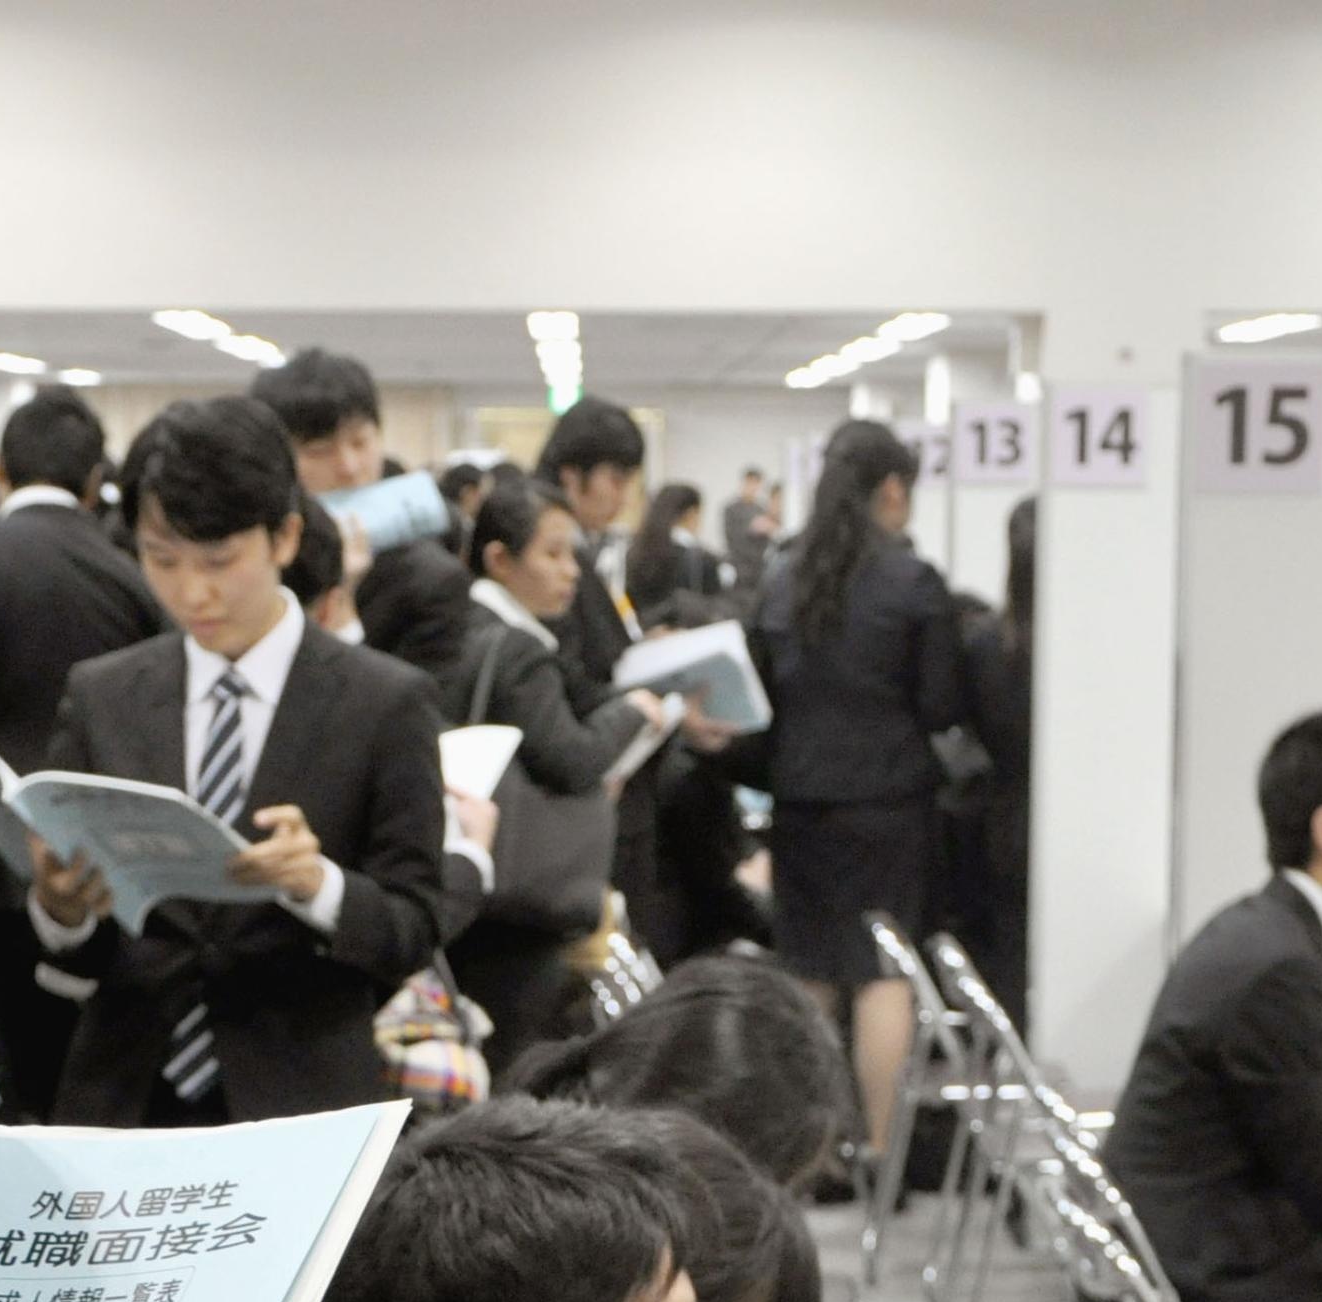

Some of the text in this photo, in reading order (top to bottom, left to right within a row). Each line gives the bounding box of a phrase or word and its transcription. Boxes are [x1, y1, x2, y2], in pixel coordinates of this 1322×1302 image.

[968, 418, 1023, 467] 13
[1065, 407, 1138, 467] 14
[1213, 384, 1311, 467] 15
[30, 1180, 239, 1220] 外国人留学生
